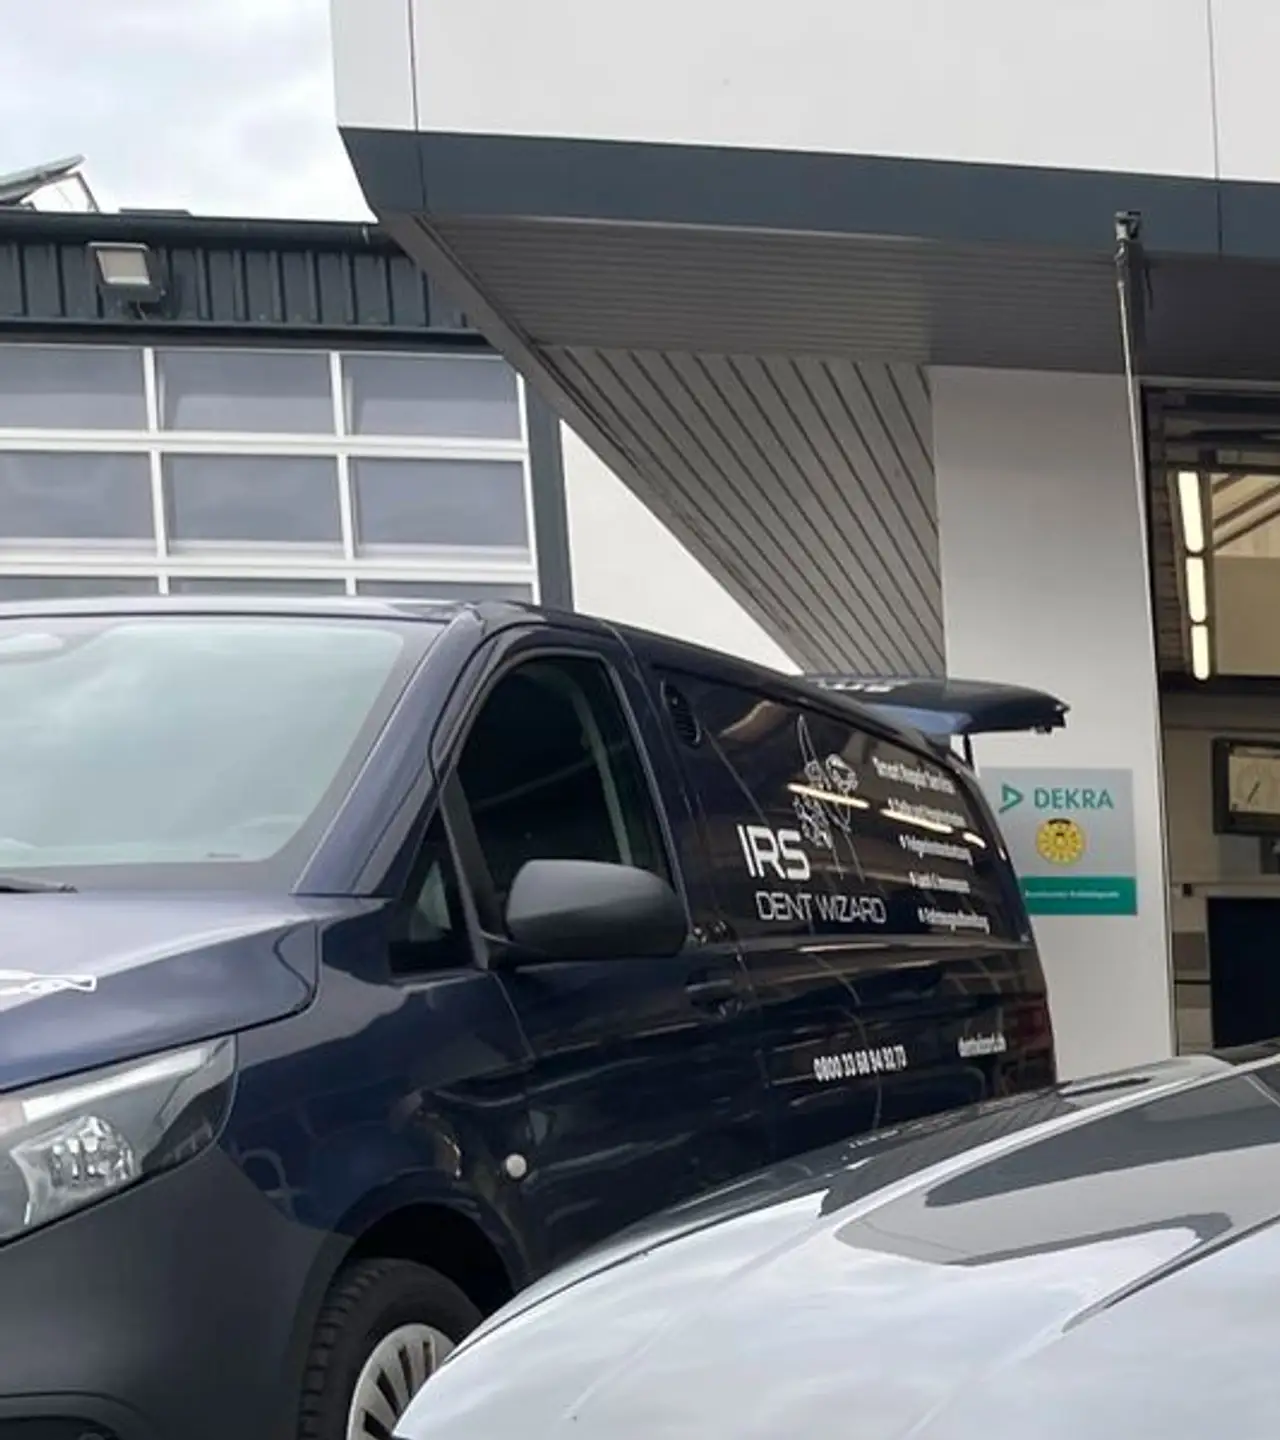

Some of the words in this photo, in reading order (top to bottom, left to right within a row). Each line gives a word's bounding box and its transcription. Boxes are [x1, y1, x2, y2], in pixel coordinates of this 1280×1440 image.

[1033, 786, 1115, 810] DEKRA
[736, 824, 811, 881] IRS
[755, 889, 813, 922] DENT
[815, 893, 888, 925] WIZARD
